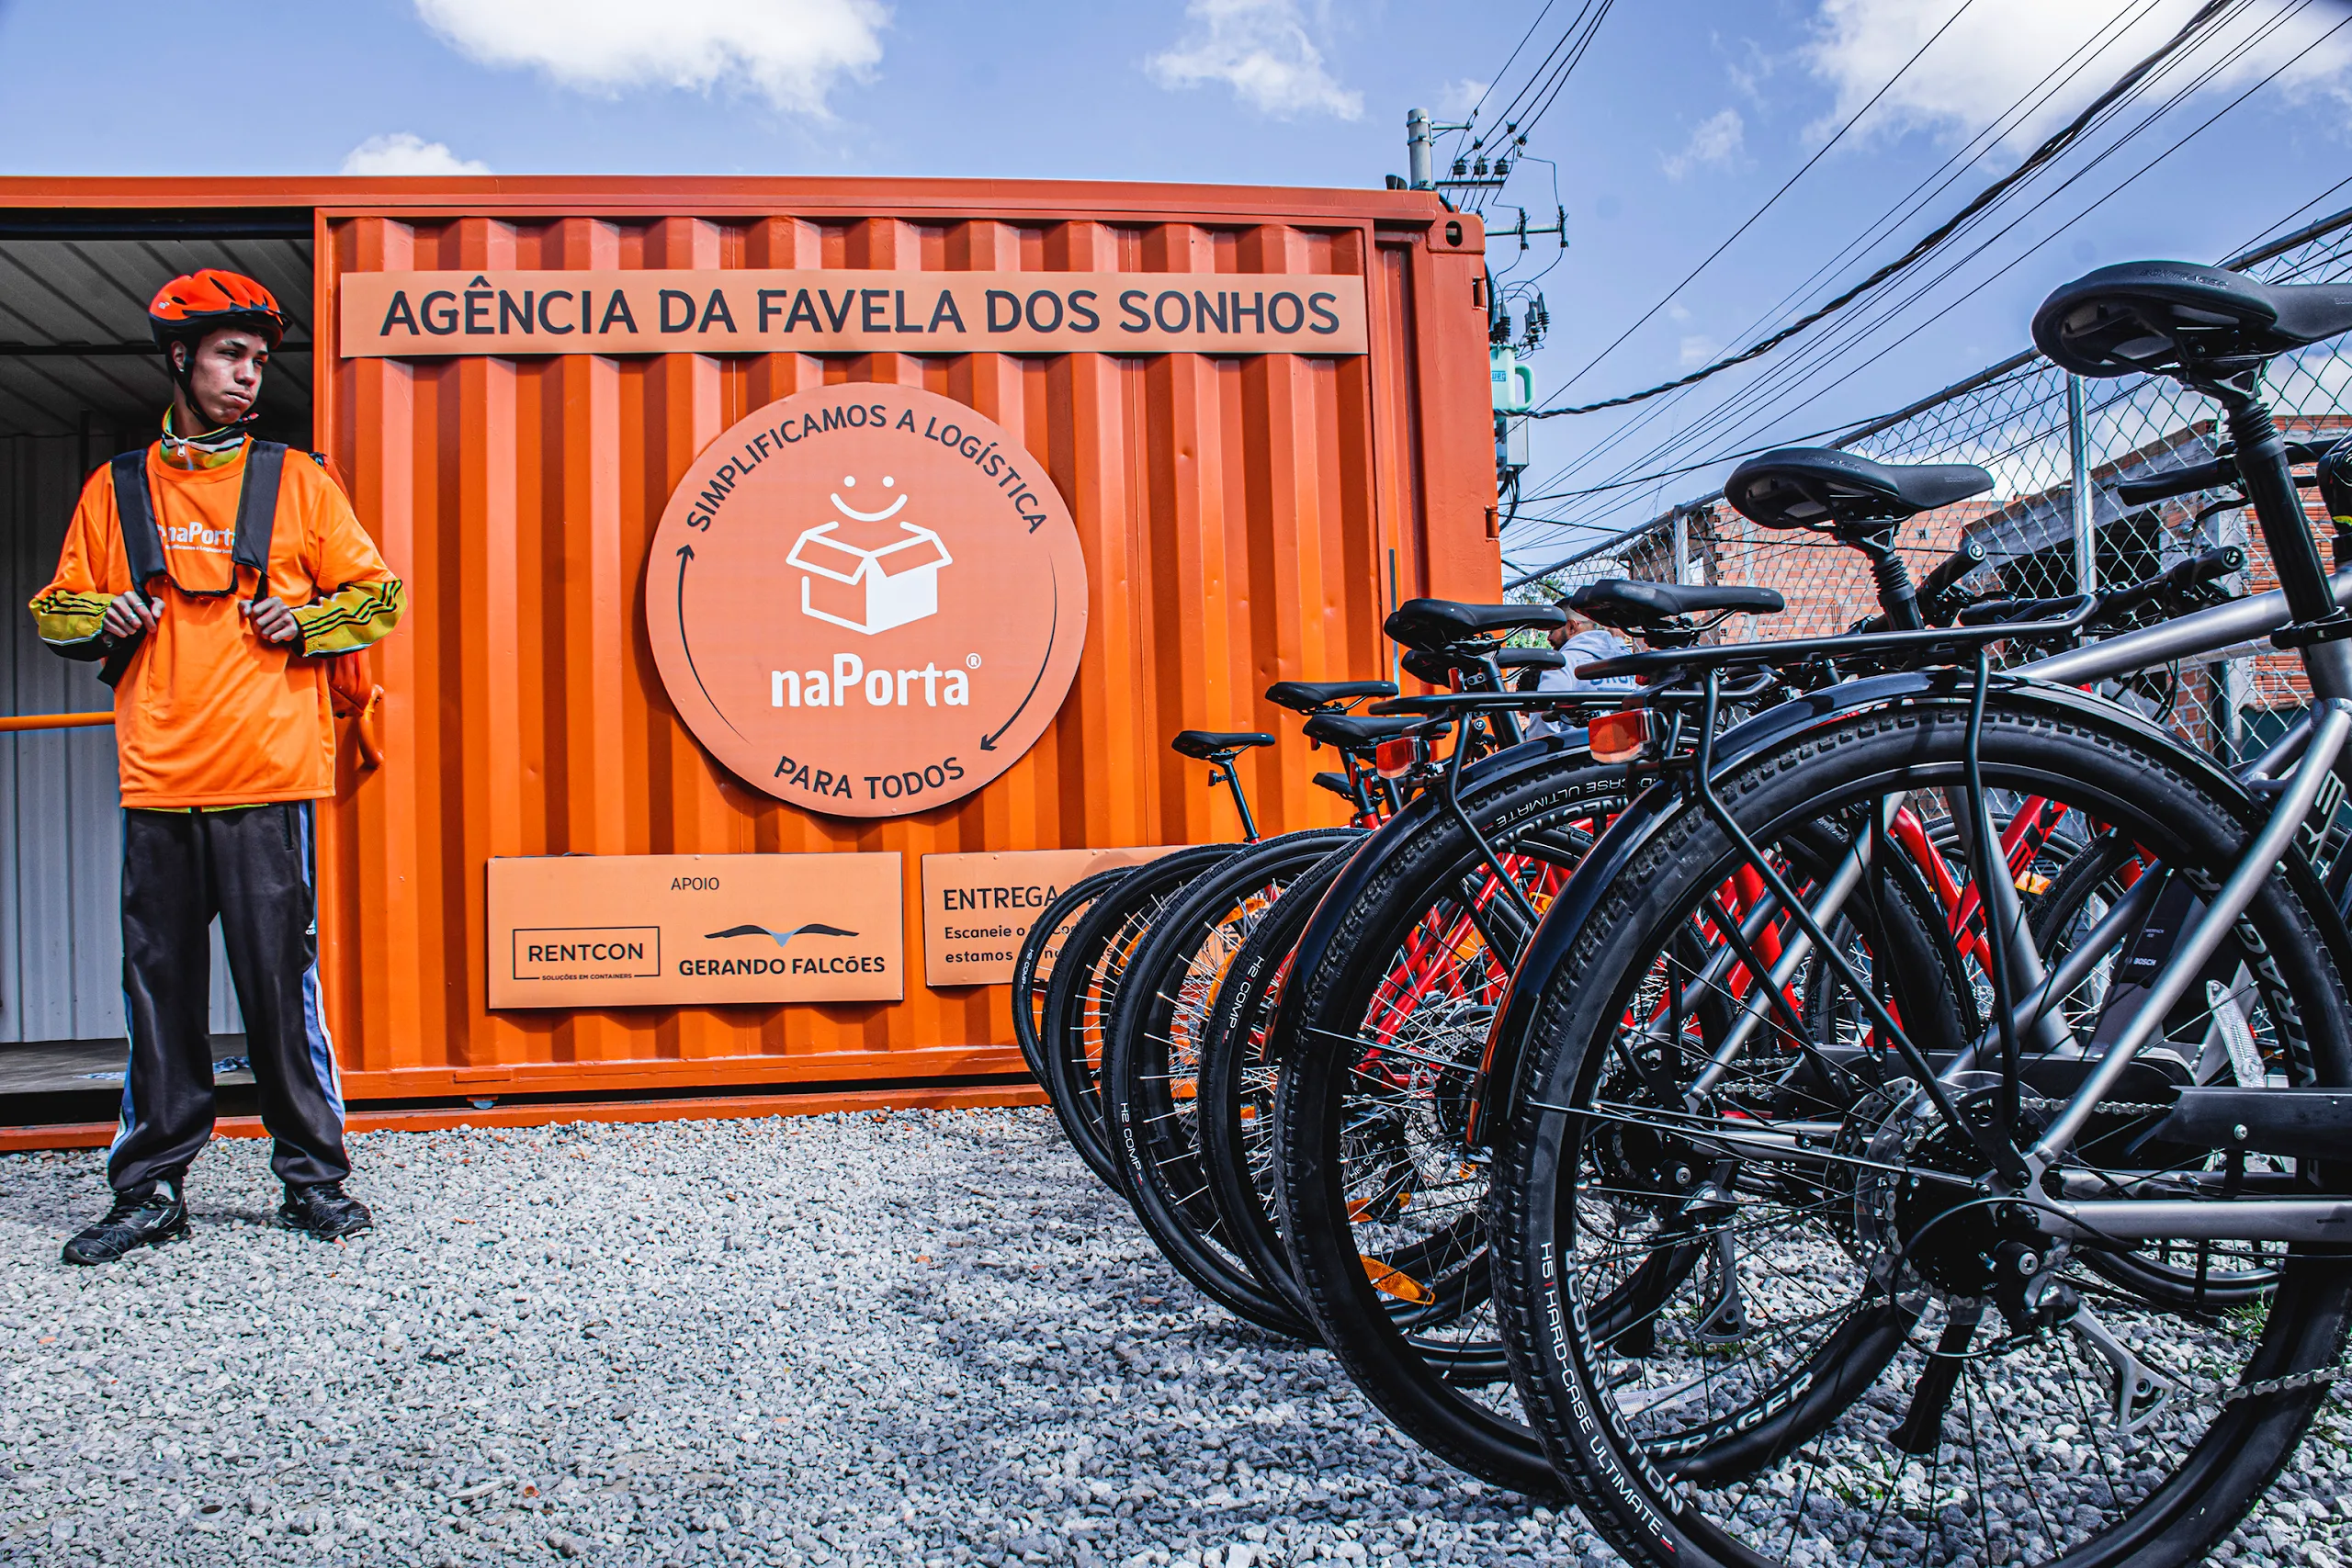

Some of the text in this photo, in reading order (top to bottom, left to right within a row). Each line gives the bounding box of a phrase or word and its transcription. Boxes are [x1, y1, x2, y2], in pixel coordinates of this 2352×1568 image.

[379, 275, 1340, 337] AGÊNCIA DA FAVELA DOS SONHOS
[686, 404, 1048, 535] SIMPLIFICAMOS A LOGÍSTICA
[774, 755, 965, 800] PARA TODOS
[1496, 788, 1580, 828] ULTIMATE
[671, 876, 720, 891] APOIO
[943, 885, 1057, 910] ENTREGA
[528, 942, 643, 962] RENTCON
[944, 924, 1012, 940] Escaneie
[1016, 927, 1025, 937] o
[679, 958, 786, 976] GERANDO
[945, 951, 1013, 964] estamos
[1022, 961, 1030, 985] COMP
[2133, 957, 2156, 966] BOSCH
[1229, 981, 1251, 1029] COMP
[1123, 1127, 1142, 1171] COMP
[1540, 1241, 1663, 1536] H5 HARD-CASE ULTIMATE
[1566, 1272, 1684, 1517] CONNECTION
[1643, 1371, 1814, 1459] TRAGER
